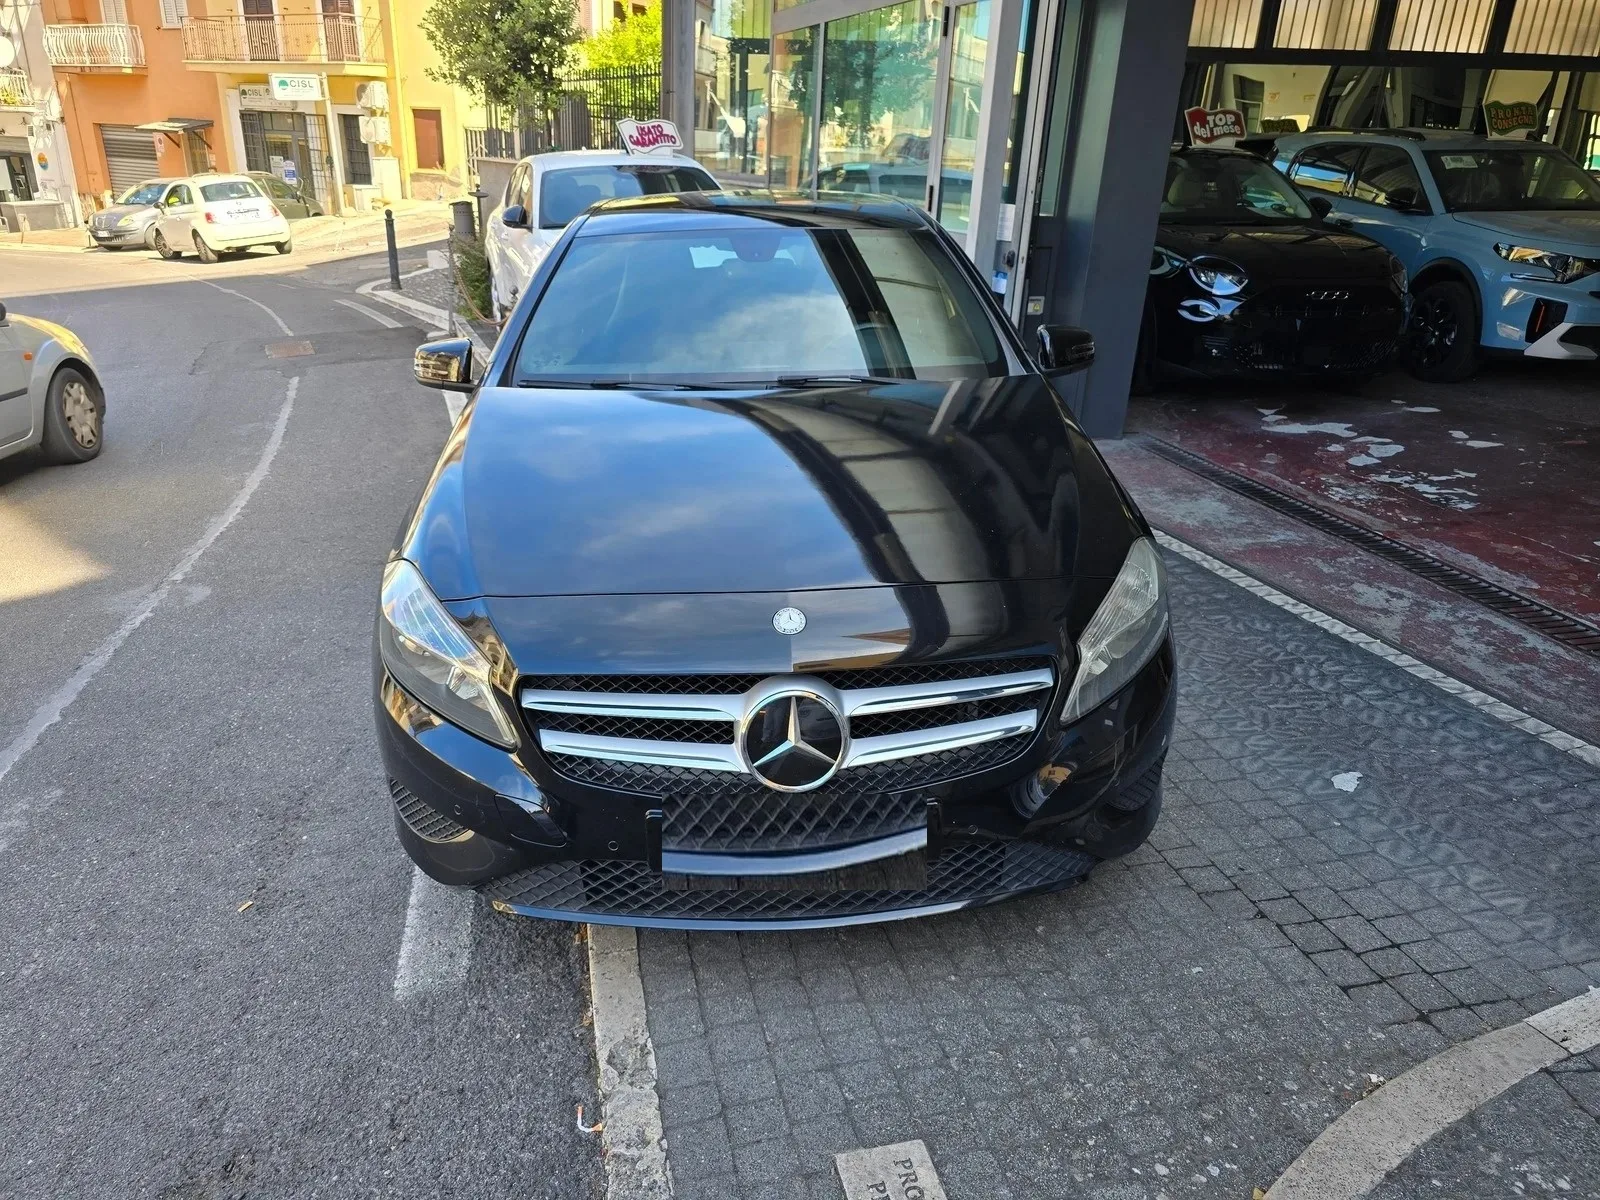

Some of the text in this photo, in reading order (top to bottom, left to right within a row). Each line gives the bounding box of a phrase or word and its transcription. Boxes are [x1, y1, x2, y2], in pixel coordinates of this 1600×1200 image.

[289, 79, 314, 89] CISL
[247, 88, 263, 97] CISL
[1490, 106, 1533, 119] PRONTA
[1207, 113, 1235, 128] TOP
[1491, 115, 1534, 130] CONSEGNA
[636, 124, 664, 137] USATO
[1193, 121, 1241, 138] del mese
[629, 133, 677, 148] GARANTITO
